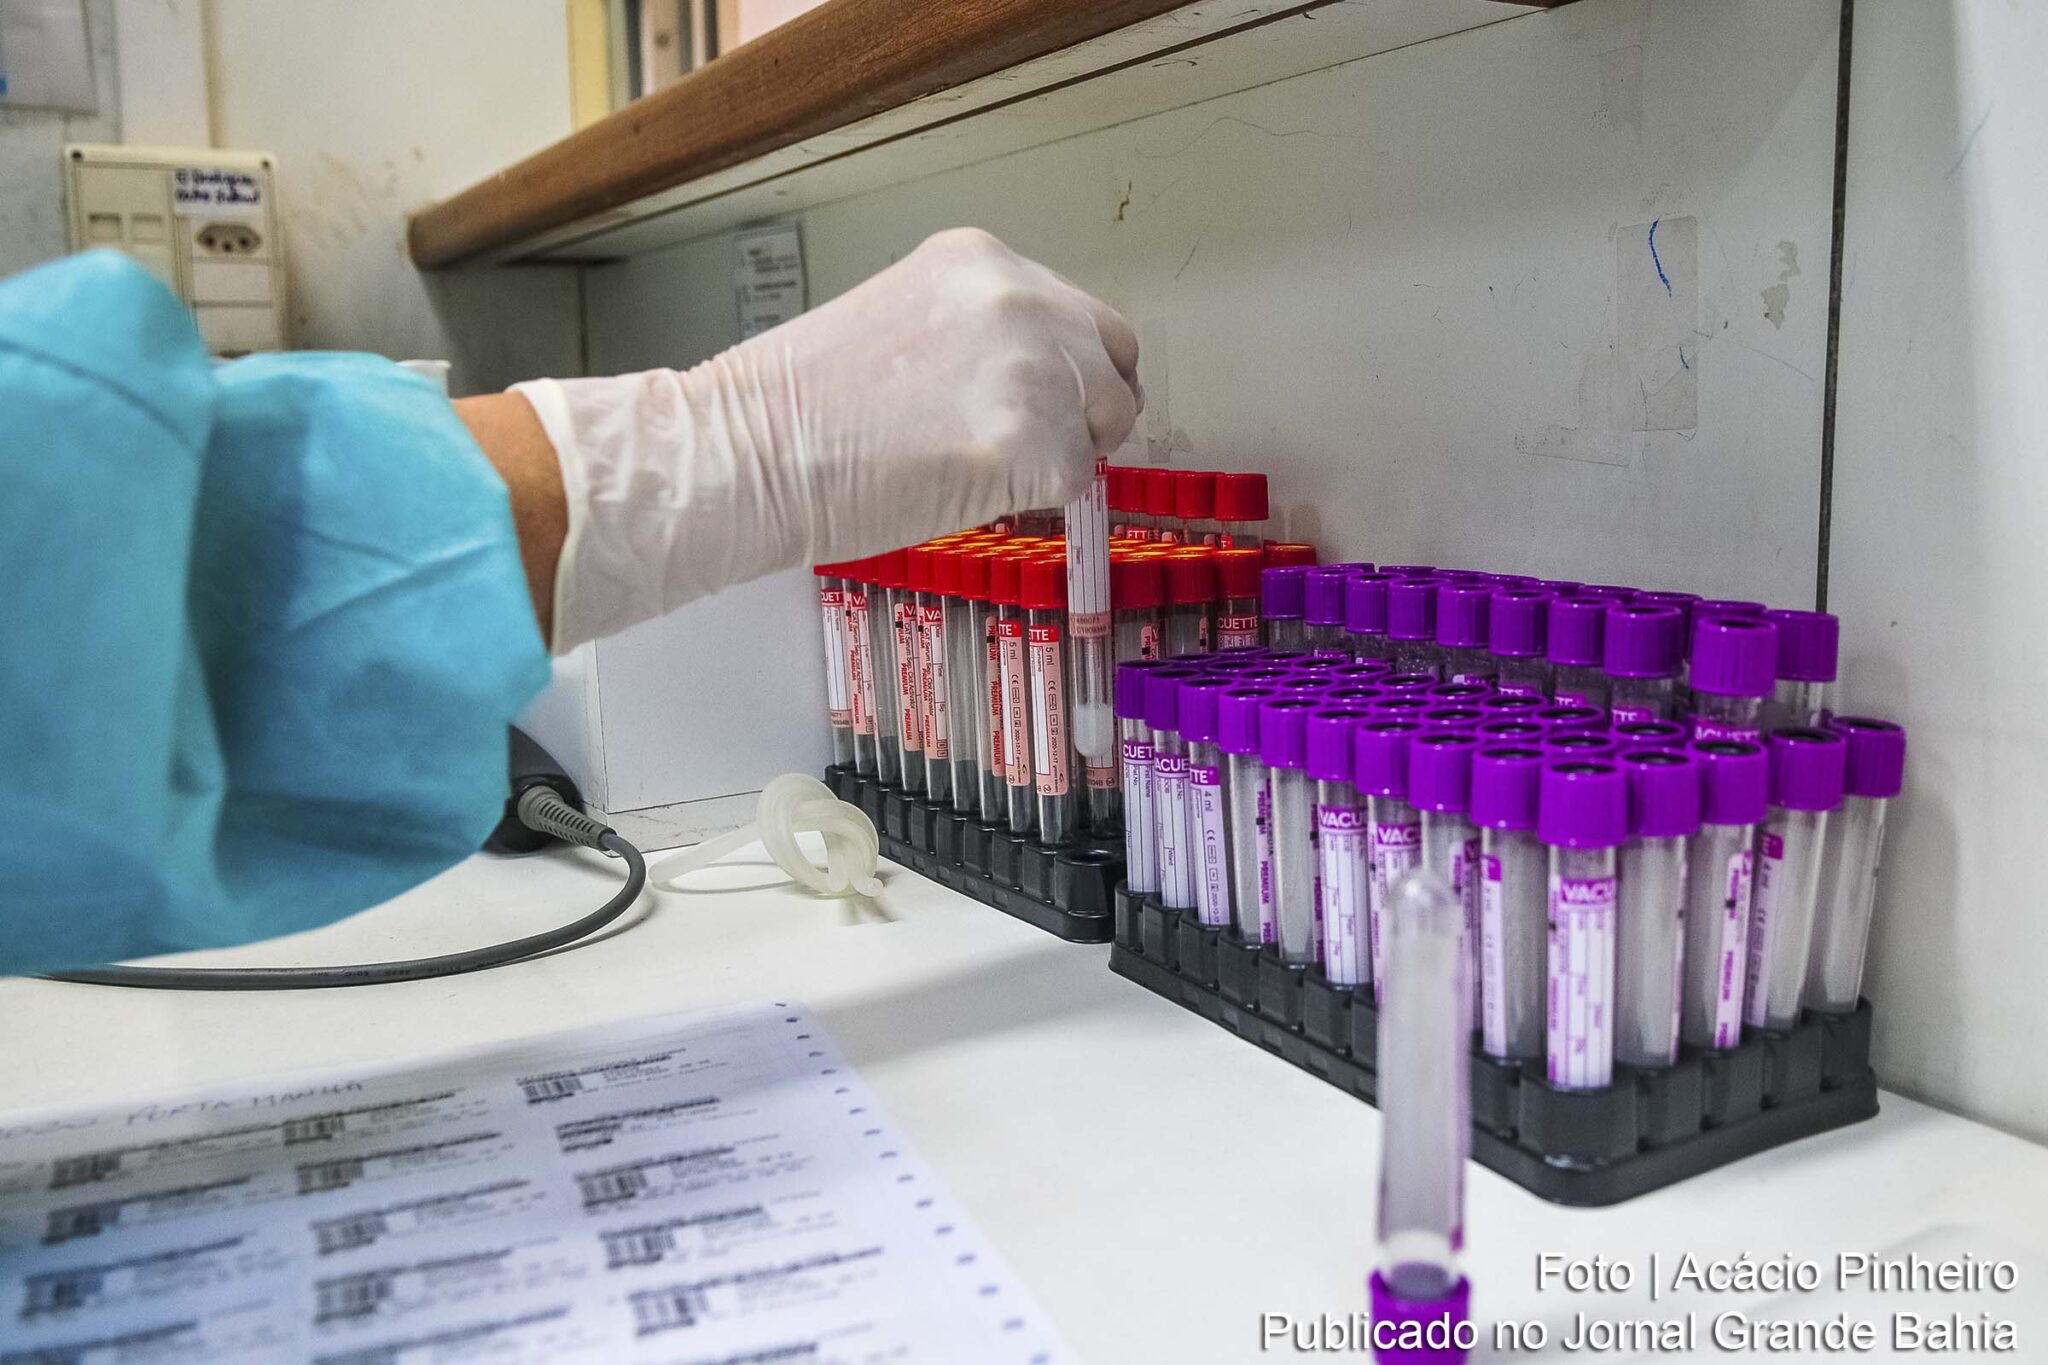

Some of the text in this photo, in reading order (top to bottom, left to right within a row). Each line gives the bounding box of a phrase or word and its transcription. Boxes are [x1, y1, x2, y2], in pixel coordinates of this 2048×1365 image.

[1010, 649, 1018, 660] ml
[1046, 654, 1055, 666] ml
[901, 662, 909, 696] PREMIUM
[991, 681, 999, 717] PREMIUM
[904, 709, 912, 741] PREMIUM
[924, 715, 932, 748] PREMIUM
[992, 730, 1001, 766] PREMIUM
[1014, 729, 1022, 757] 2020-12-17
[1051, 736, 1059, 764] 2020-12-17
[1204, 799, 1213, 812] ml
[1320, 811, 1361, 828] VACU
[1378, 827, 1418, 844] VAC
[1260, 860, 1269, 905] PREMIUM
